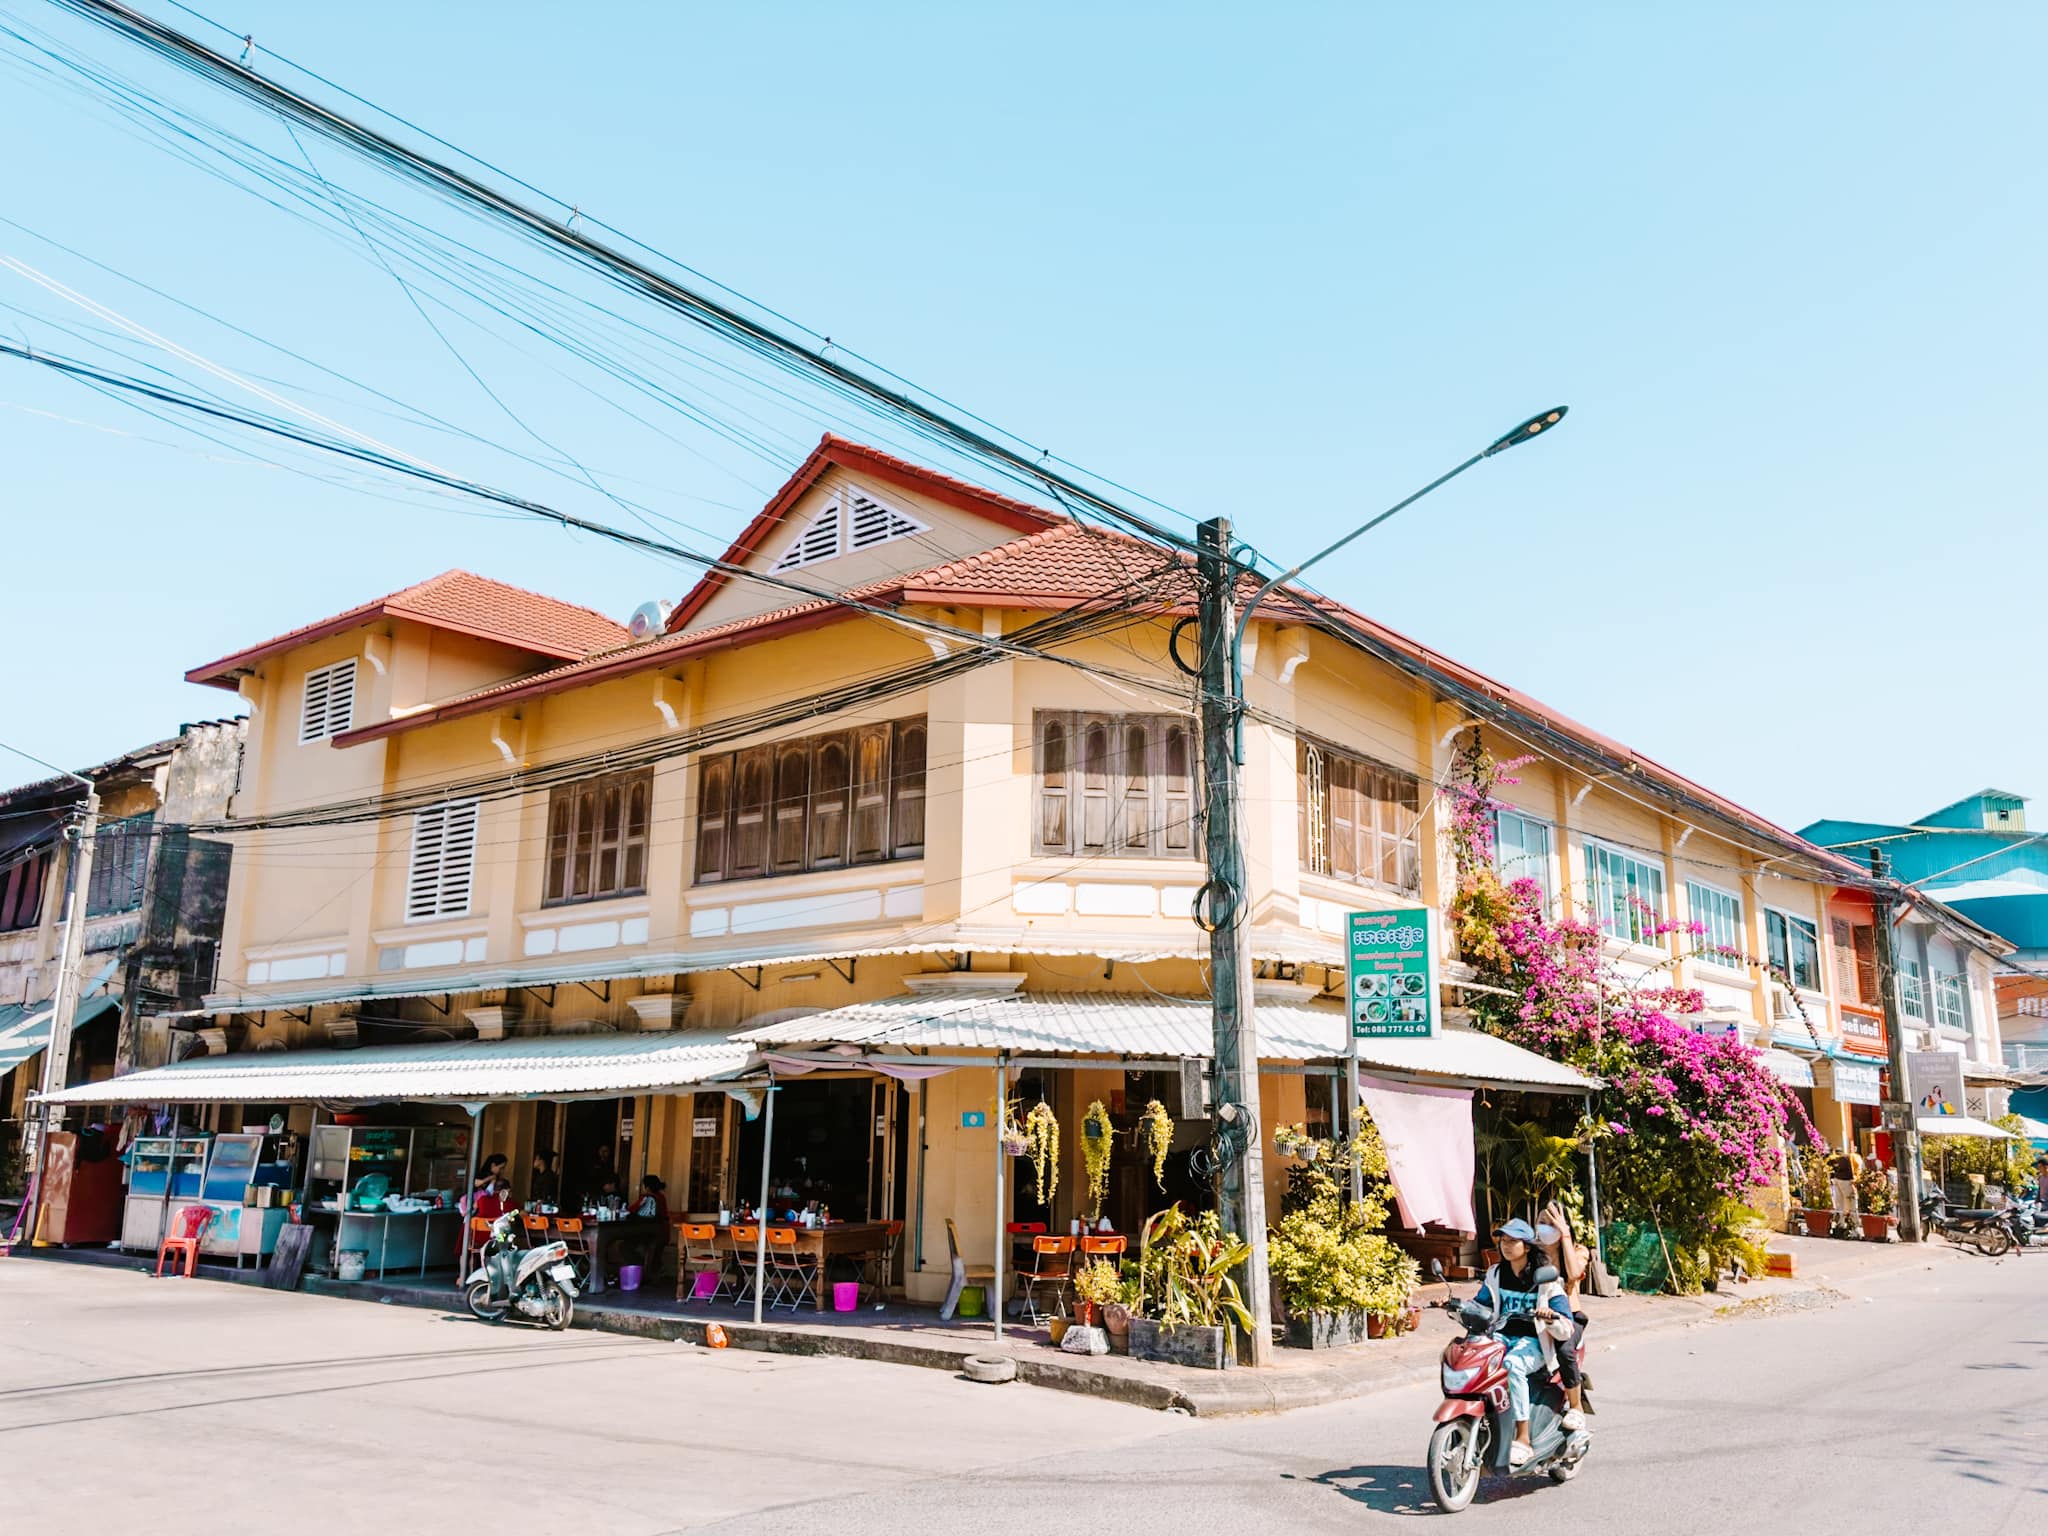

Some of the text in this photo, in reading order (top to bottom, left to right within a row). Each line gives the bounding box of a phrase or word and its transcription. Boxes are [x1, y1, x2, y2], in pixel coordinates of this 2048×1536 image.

[1356, 1025, 1370, 1033] Tel:
[1387, 1025, 1402, 1033] 777
[1404, 1025, 1415, 1033] 42
